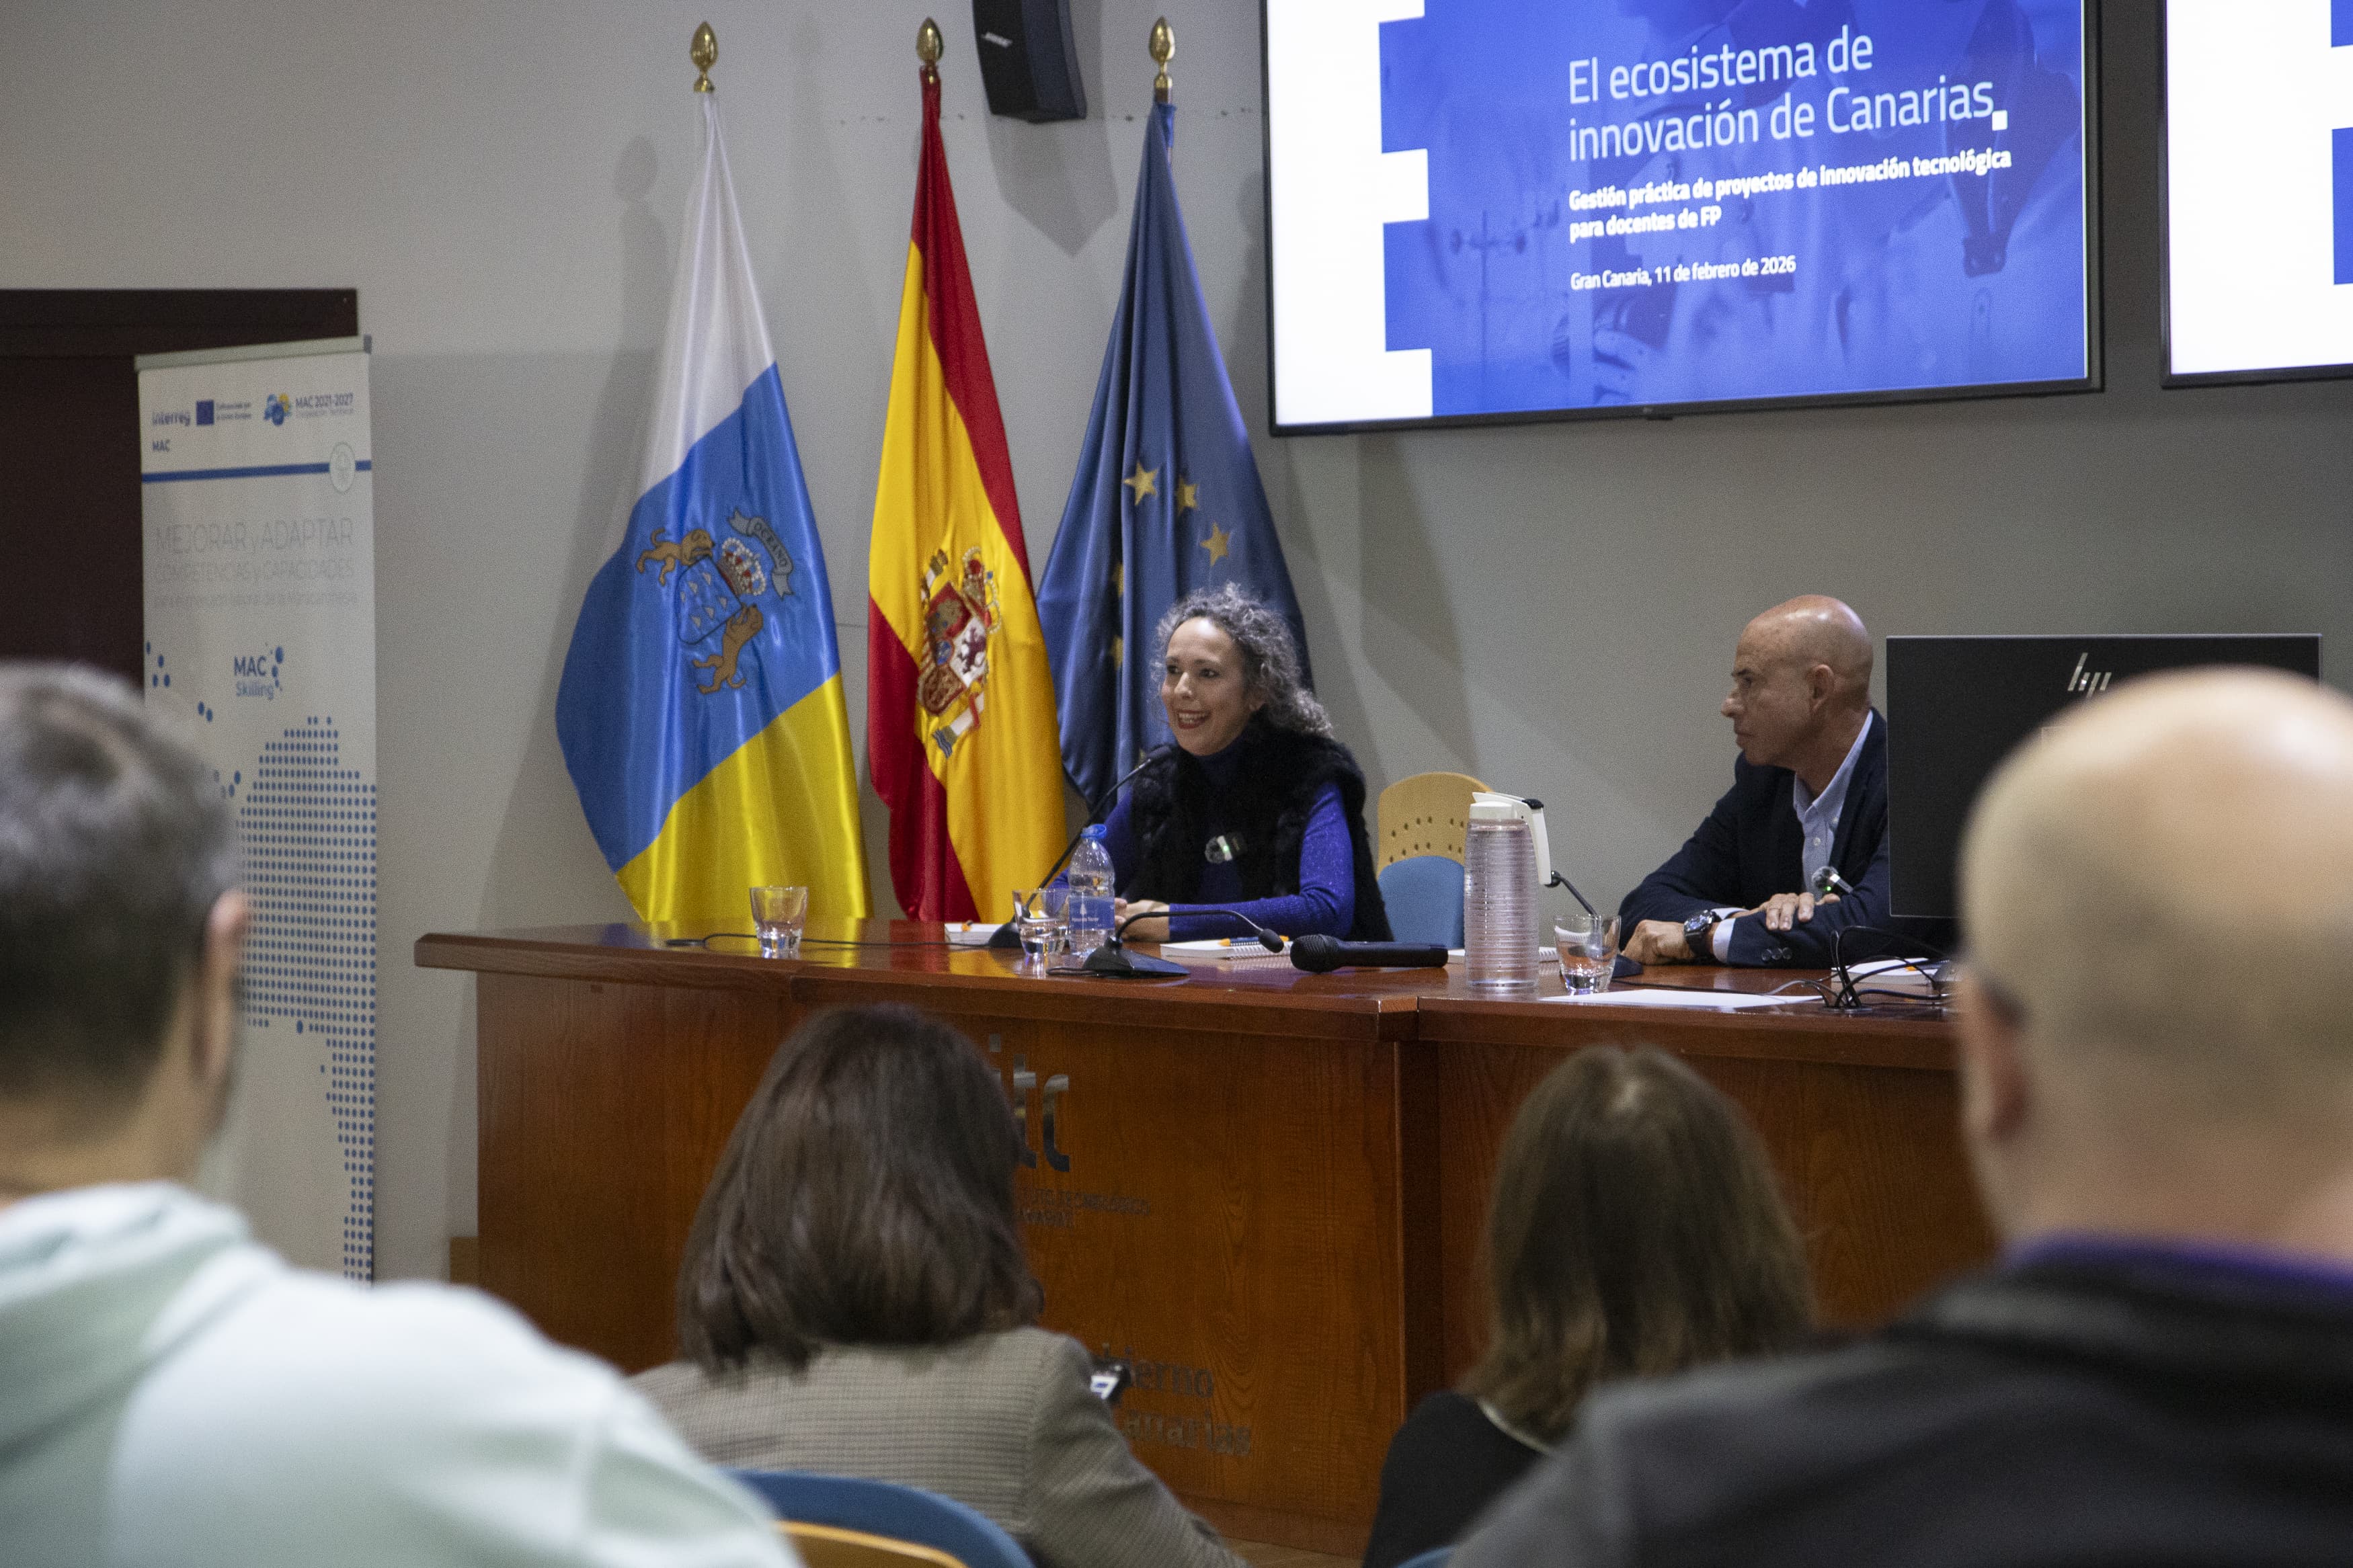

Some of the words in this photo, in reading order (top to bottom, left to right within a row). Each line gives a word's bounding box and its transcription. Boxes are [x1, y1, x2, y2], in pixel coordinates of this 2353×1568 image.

[1569, 56, 1598, 104] El
[1609, 43, 1817, 99] ecosistema
[1827, 24, 1873, 73] de
[1570, 97, 1758, 161] innovación
[1770, 92, 1815, 140] de
[1569, 185, 1627, 210] Gestión
[1628, 181, 1691, 210] práctica
[1692, 177, 1714, 198] de
[1715, 171, 1794, 202] proyectos
[1796, 167, 1818, 188] de
[1819, 157, 1911, 186] innovación
[1912, 147, 2012, 177] tecnológica
[1569, 220, 1605, 244] para
[1605, 214, 1676, 236] docentes
[1677, 208, 1699, 229] de
[1700, 205, 1722, 226] FP
[1570, 272, 1601, 290] Gran
[1601, 267, 1652, 287] Canaria,
[1654, 265, 1671, 283] 11
[1673, 263, 1691, 282] de
[1691, 261, 1741, 280] febrero
[1741, 257, 1759, 276] de
[1760, 255, 1797, 275] 2026
[296, 397, 314, 409] MAC
[260, 517, 354, 550] ADAPTAR
[233, 656, 267, 677] MAC
[236, 681, 274, 700] Skilling
